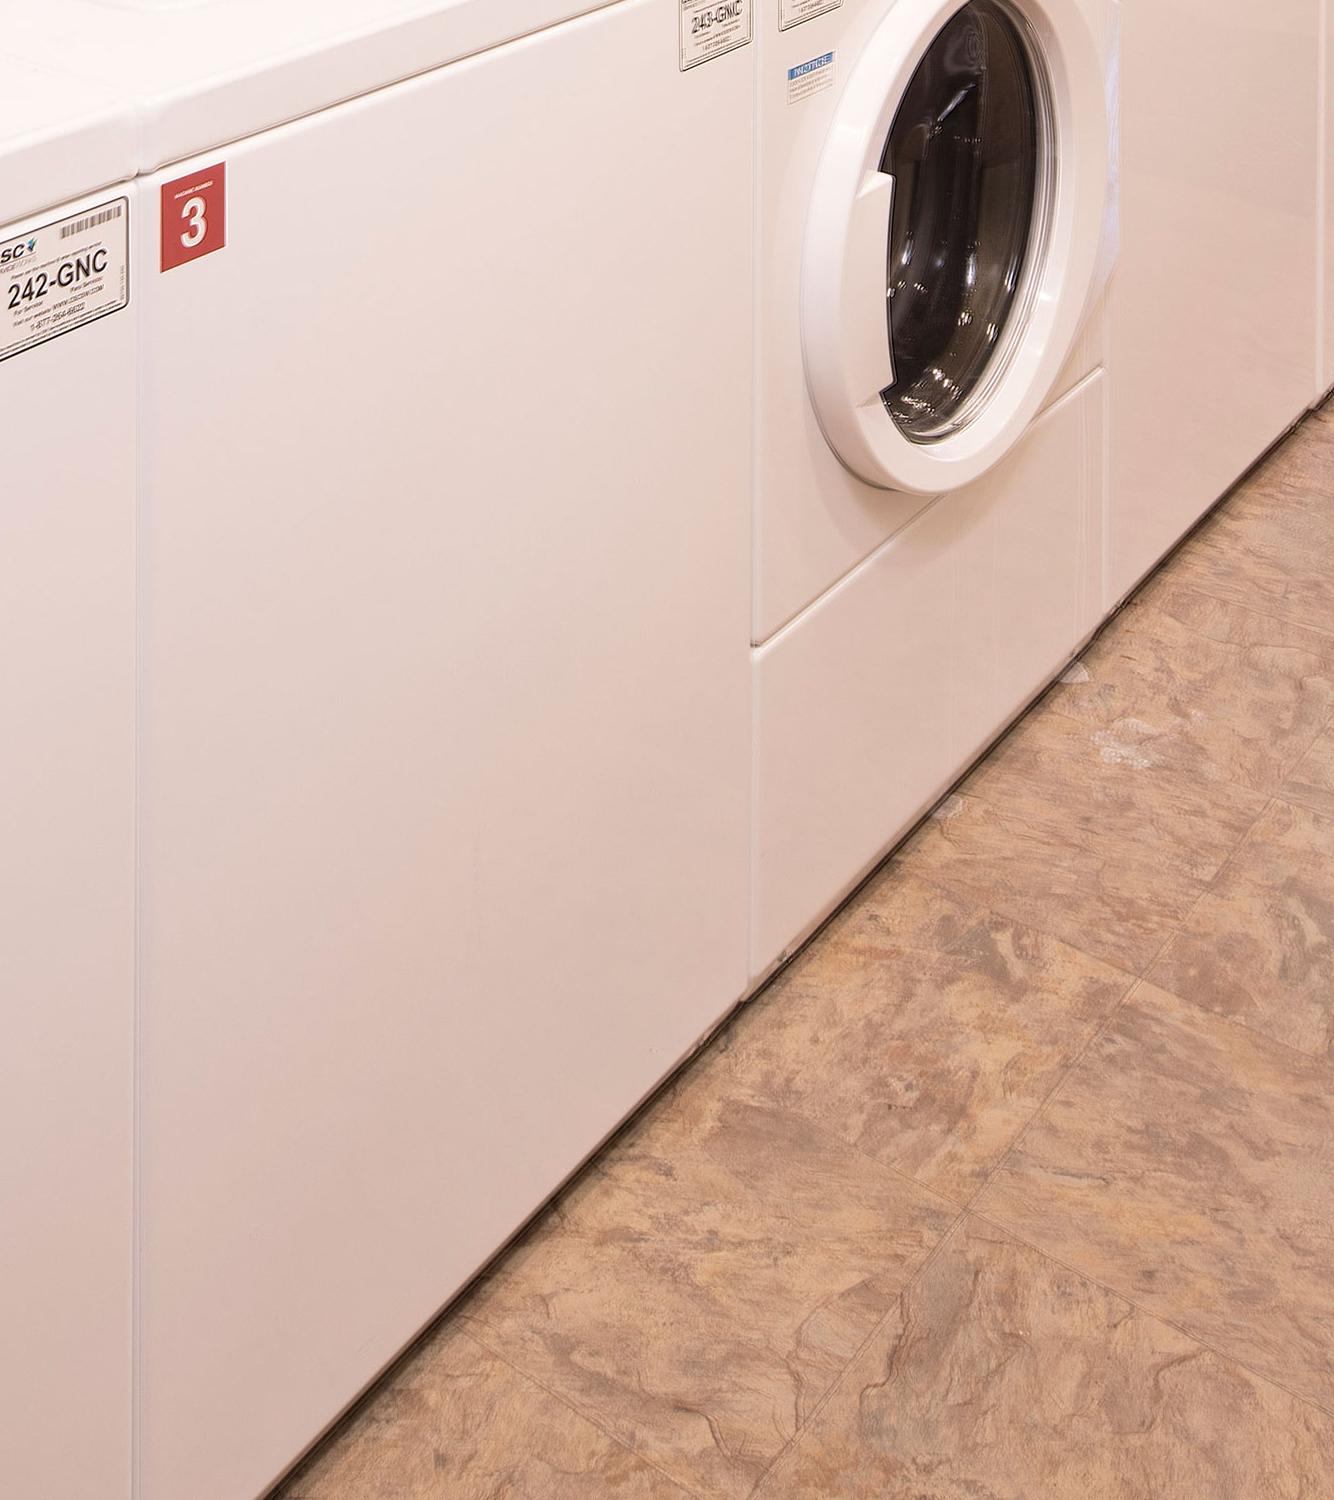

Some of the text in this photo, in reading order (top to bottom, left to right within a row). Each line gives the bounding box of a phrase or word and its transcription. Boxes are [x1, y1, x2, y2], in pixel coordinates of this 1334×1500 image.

[793, 54, 830, 78] NOTICE
[179, 195, 209, 249] 3
[7, 249, 108, 310] 242-GNC
